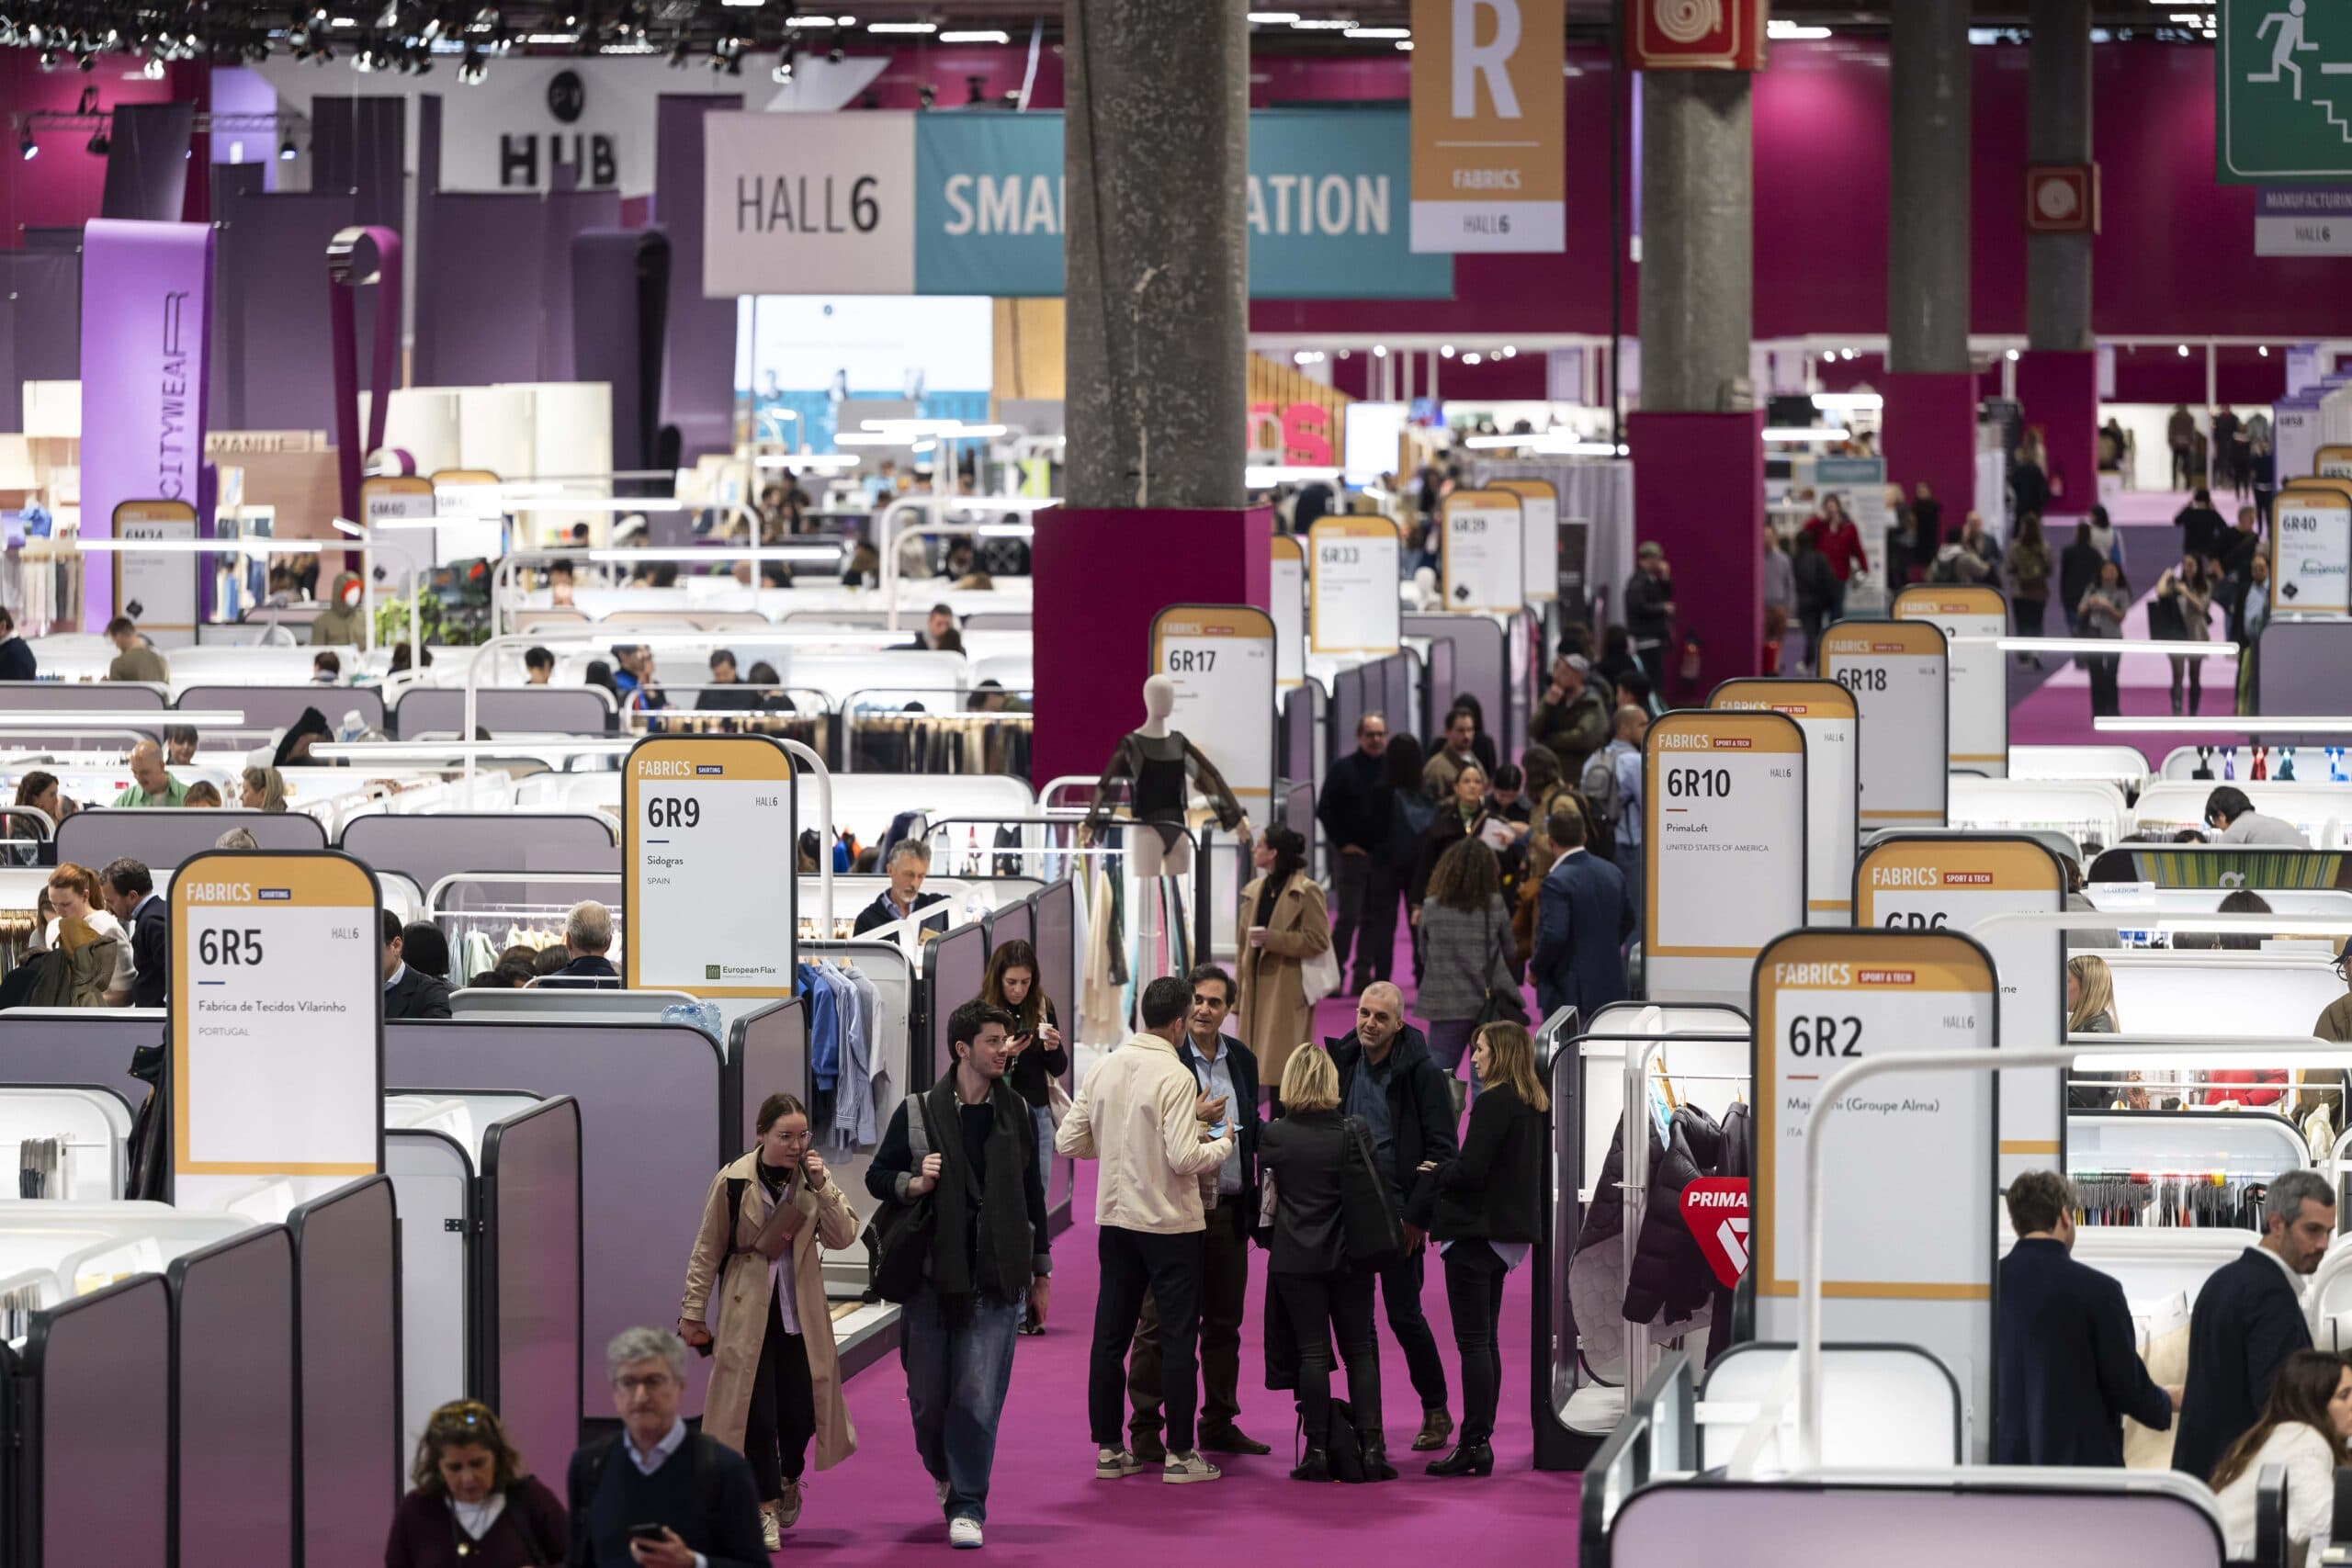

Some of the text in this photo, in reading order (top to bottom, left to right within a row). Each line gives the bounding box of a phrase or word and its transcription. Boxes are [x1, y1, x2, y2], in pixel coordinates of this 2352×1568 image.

[1452, 0, 1522, 118] R
[500, 134, 617, 186] HUB
[1453, 168, 1521, 190] FABRICS
[737, 175, 880, 233] HALL6
[944, 174, 1066, 235] SMA
[1464, 214, 1511, 235] HALL6
[159, 290, 189, 501] CITYWEAR
[2282, 514, 2317, 532] 6R40
[1170, 649, 1216, 671] 6R17
[1837, 668, 1887, 691] 6R18
[1719, 700, 1768, 711] FABRICS
[1658, 734, 1710, 750] FABRICS
[638, 760, 692, 777] FABRICS
[698, 766, 721, 774] SHIRTING
[1770, 768, 1792, 779] HALL6
[1668, 768, 1732, 798] 6R10
[755, 796, 778, 807] HALL6
[648, 796, 701, 828] 6R9
[1666, 823, 1709, 833] PrimaLoft
[1666, 843, 1770, 853] UNITED STATES OF AMERICA
[647, 856, 684, 868] Sidogras
[647, 876, 671, 886] SPAIN
[1872, 867, 1938, 886] FABRICS
[1946, 874, 1967, 884] SPORT
[1974, 874, 1991, 884] TECH
[187, 883, 252, 902] FABRICS
[332, 927, 359, 940] HALL6
[198, 928, 264, 966] 6R5
[722, 965, 759, 975] European
[1775, 963, 1851, 986] FABRICS
[1860, 972, 1884, 983] SPORT
[1893, 973, 1913, 983] TECH
[198, 999, 346, 1013] Fabrica de Tecidos Vilarinho
[198, 1027, 250, 1036] PORTUGAL
[1942, 1016, 1974, 1030] HALL6
[1788, 1015, 1863, 1058] 6R2
[1846, 1097, 1898, 1115] (Groupe
[1901, 1098, 1940, 1113] Alma)
[1688, 1191, 1749, 1208] PRIMA
